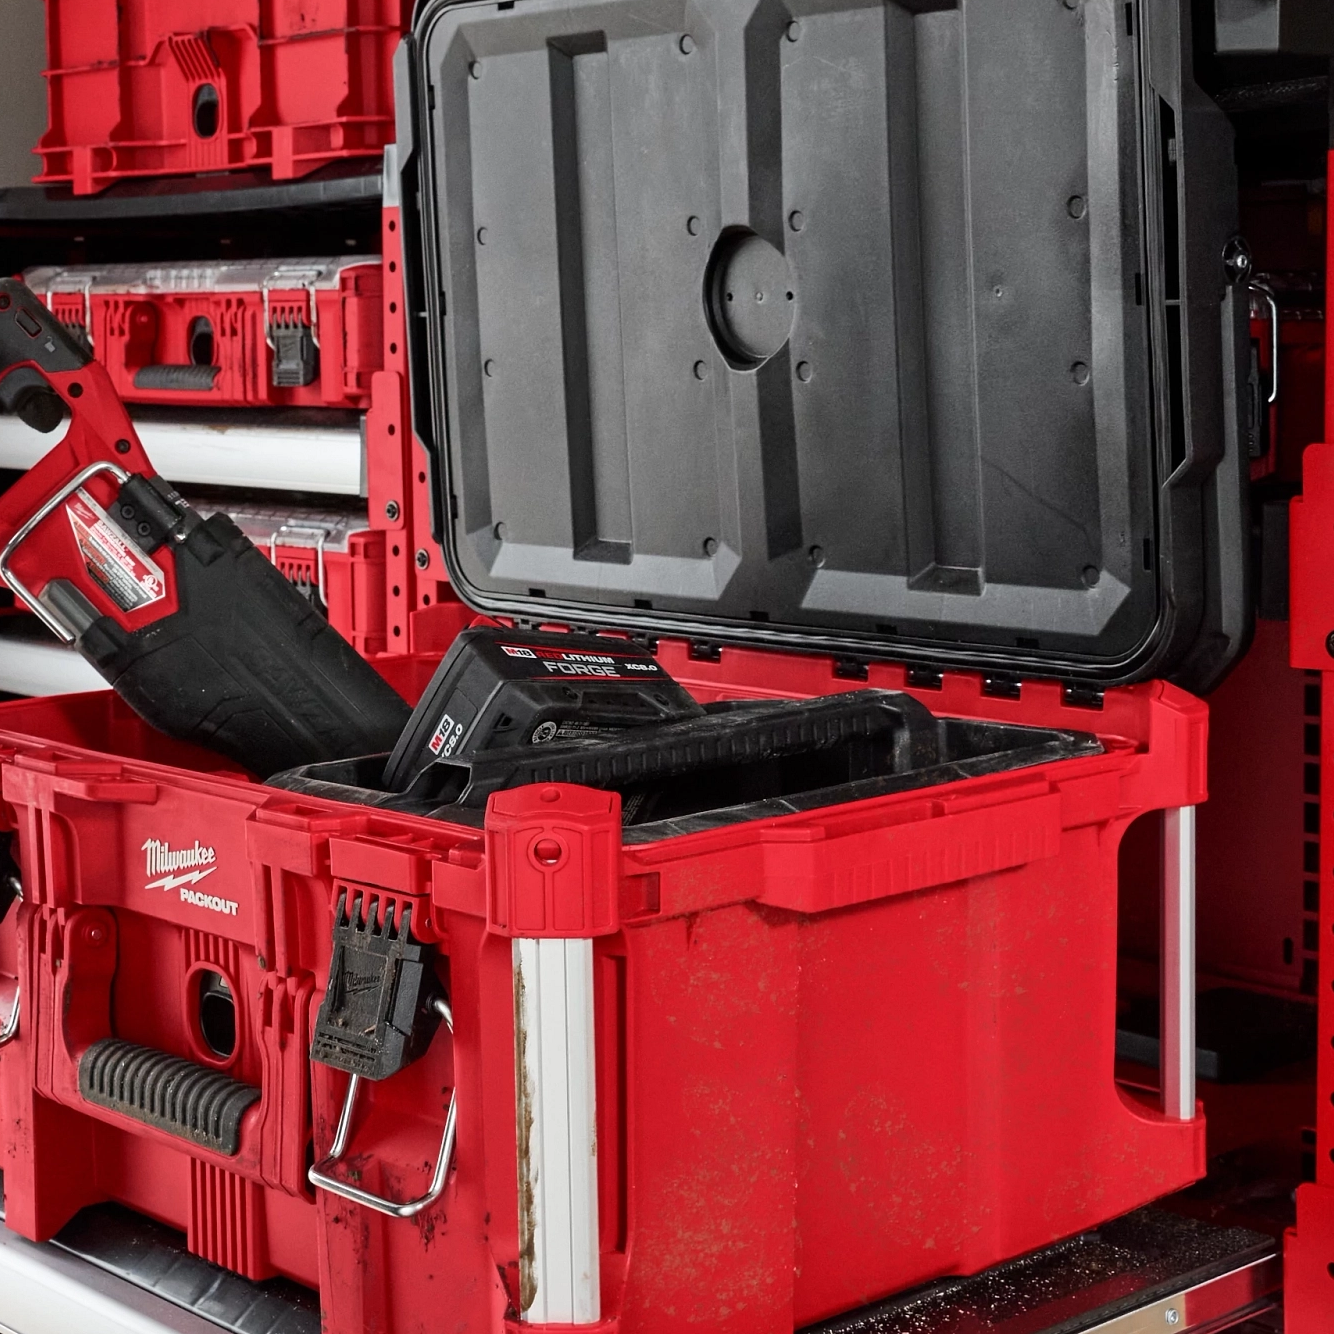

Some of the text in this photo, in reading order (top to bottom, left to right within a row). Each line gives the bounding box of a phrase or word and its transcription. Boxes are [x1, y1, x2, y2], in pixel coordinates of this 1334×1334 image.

[504, 647, 535, 658] M18
[542, 661, 621, 678] FORGE
[430, 717, 453, 753] M18
[141, 837, 217, 879] Milwaukee
[179, 887, 239, 916] PACKOUT
